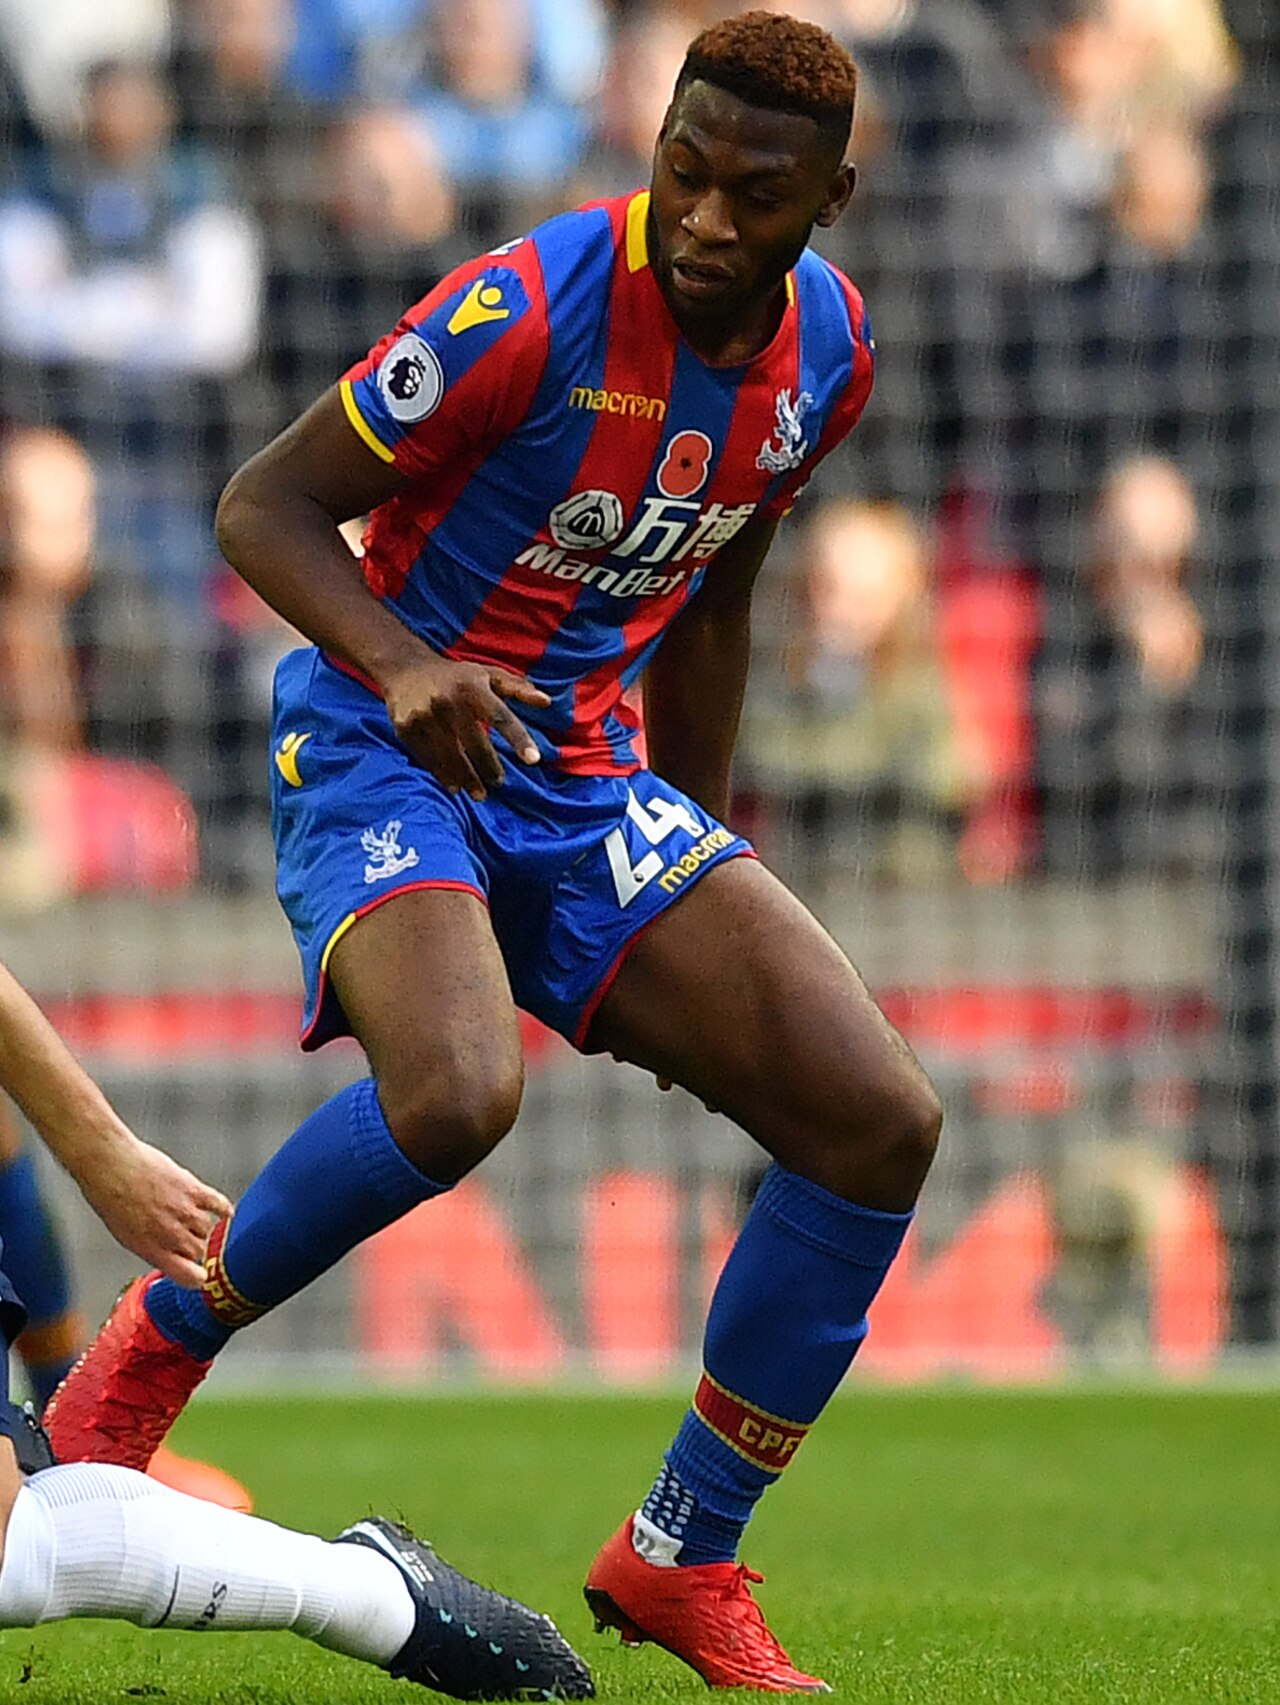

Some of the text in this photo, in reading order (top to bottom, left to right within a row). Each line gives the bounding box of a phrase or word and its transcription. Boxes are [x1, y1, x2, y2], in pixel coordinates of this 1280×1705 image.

[568, 387, 666, 422] macron
[608, 497, 757, 562] 万博
[514, 543, 701, 598] ManBet
